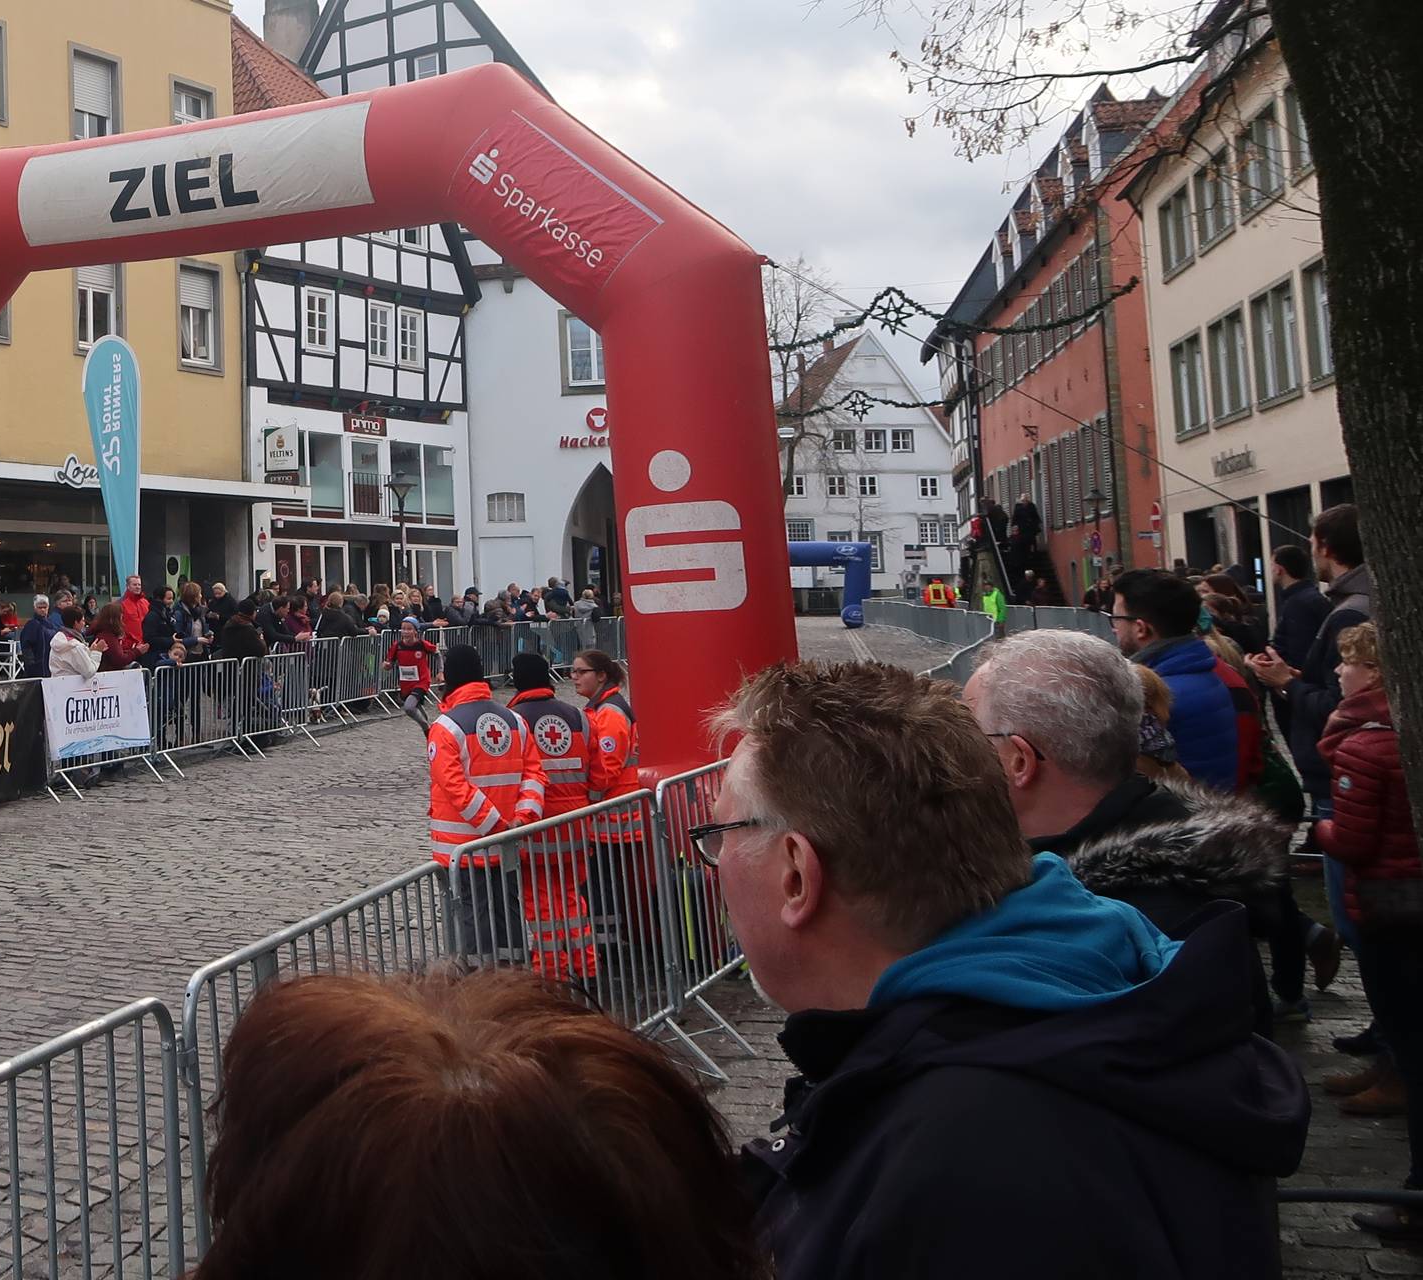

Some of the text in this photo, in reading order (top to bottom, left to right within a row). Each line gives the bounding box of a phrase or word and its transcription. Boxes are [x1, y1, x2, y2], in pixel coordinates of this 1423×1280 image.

[109, 153, 260, 222] ZIEL
[493, 173, 604, 268] Sparkasse
[351, 417, 381, 431] primo
[269, 450, 294, 458] VELTINS
[65, 695, 120, 725] GERMETA
